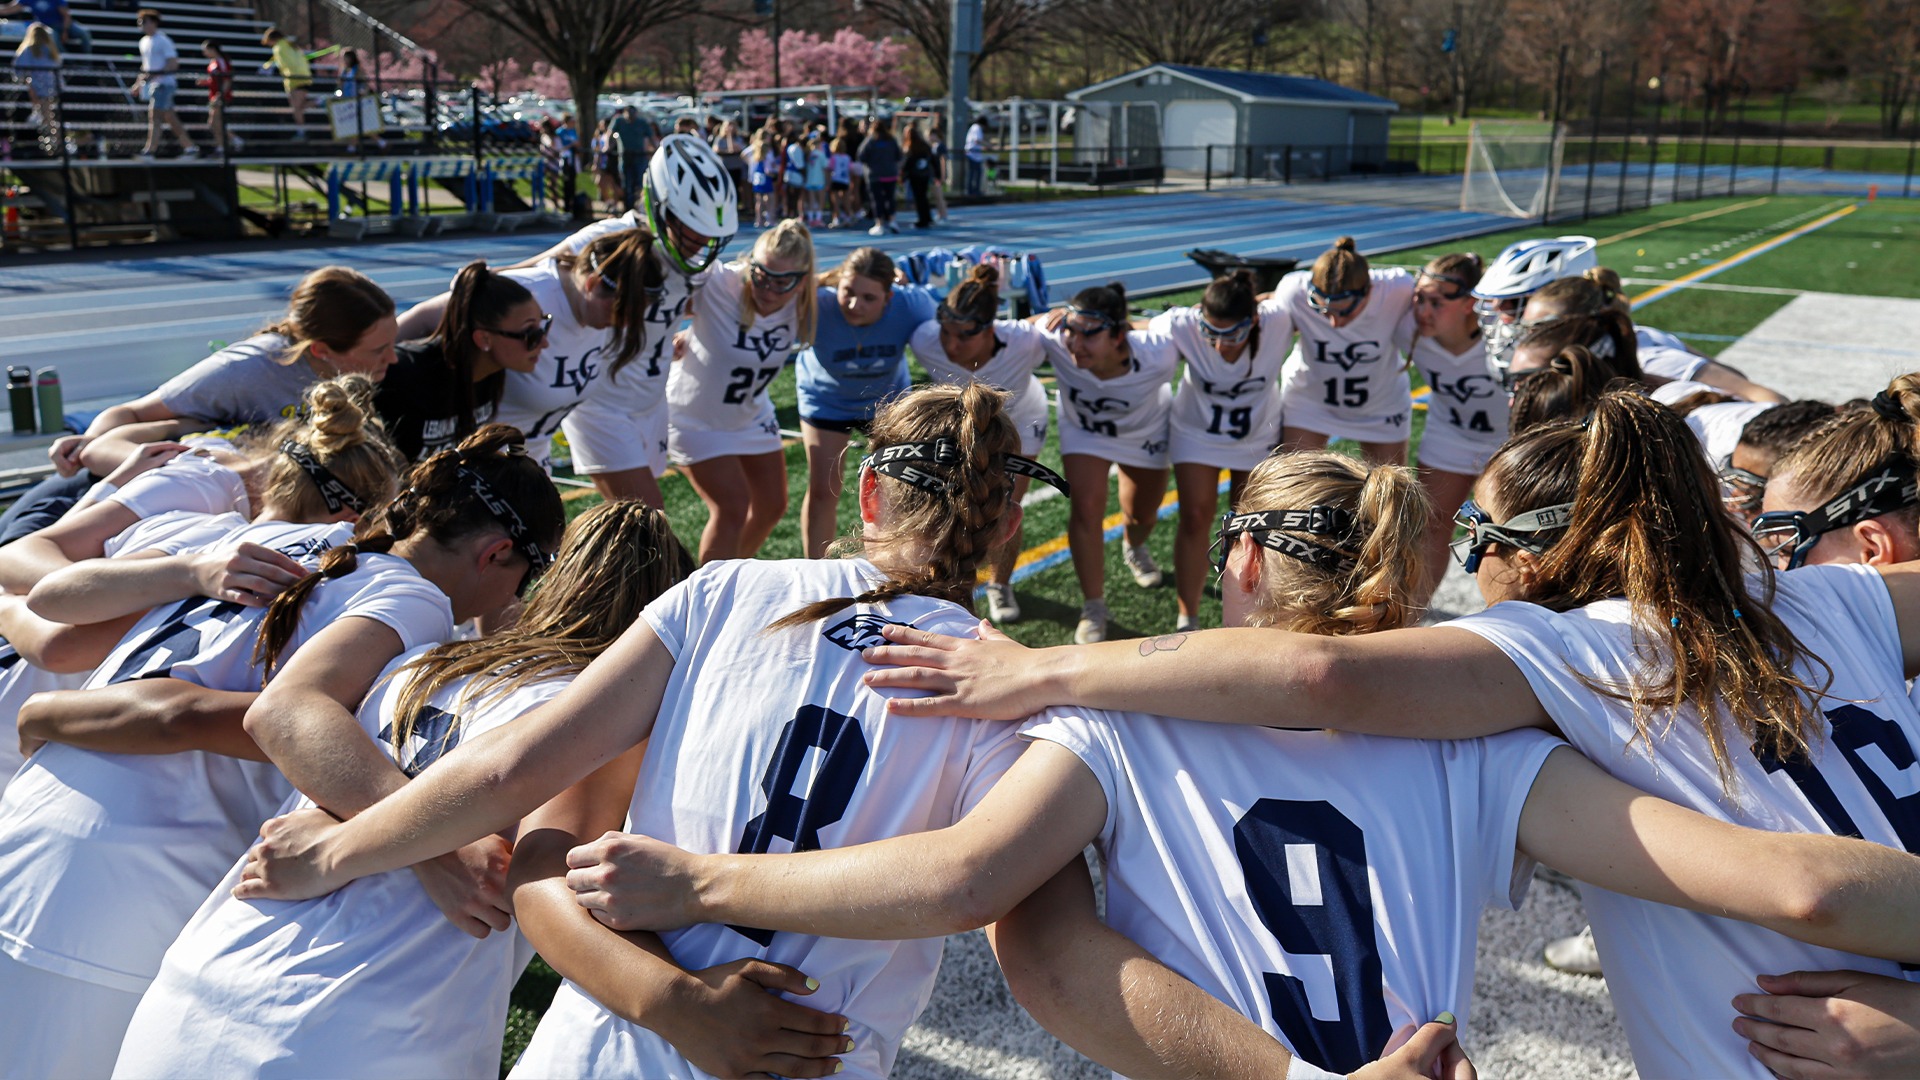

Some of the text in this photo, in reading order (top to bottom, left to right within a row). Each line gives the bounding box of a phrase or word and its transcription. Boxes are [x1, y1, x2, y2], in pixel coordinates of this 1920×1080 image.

[732, 325, 791, 362] LVC
[1314, 339, 1380, 372] LVC
[550, 346, 601, 396] LVC
[723, 366, 779, 404] 27
[1426, 368, 1495, 405] LVC
[1323, 375, 1369, 408] 15
[1206, 404, 1252, 440] 19
[881, 444, 925, 461] STX
[1004, 456, 1059, 485] STX
[1825, 467, 1900, 521] STX
[1228, 512, 1270, 531] STX
[1266, 531, 1320, 562] STX
[829, 624, 890, 650] MA
[1233, 798, 1394, 1076] 9
